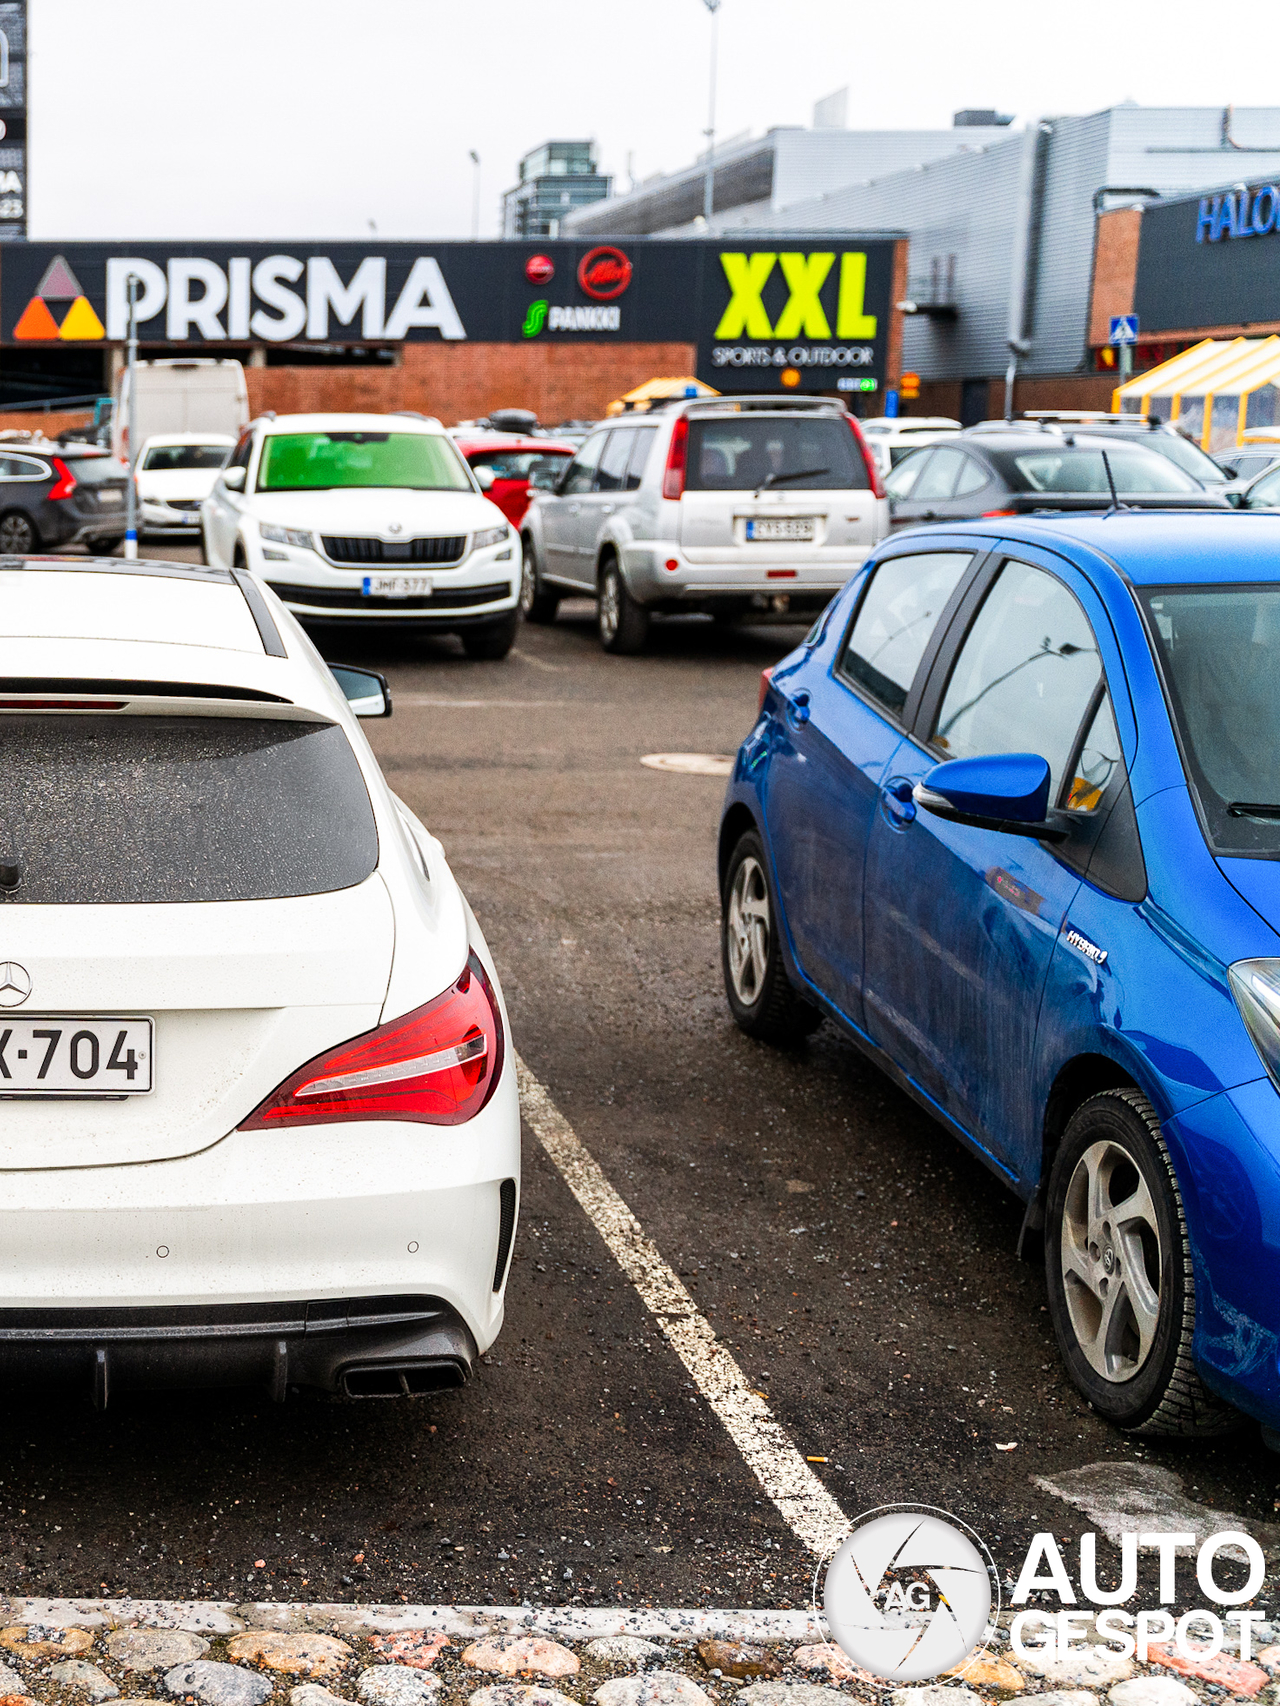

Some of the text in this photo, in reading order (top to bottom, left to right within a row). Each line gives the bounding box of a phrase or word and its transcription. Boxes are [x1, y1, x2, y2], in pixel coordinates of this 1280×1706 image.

[1196, 186, 1280, 243] HALO
[105, 255, 468, 342] PRISMA
[548, 306, 621, 331] PANKKI
[714, 251, 878, 340] XXL
[711, 346, 875, 368] SPORTS & OUTDOOR
